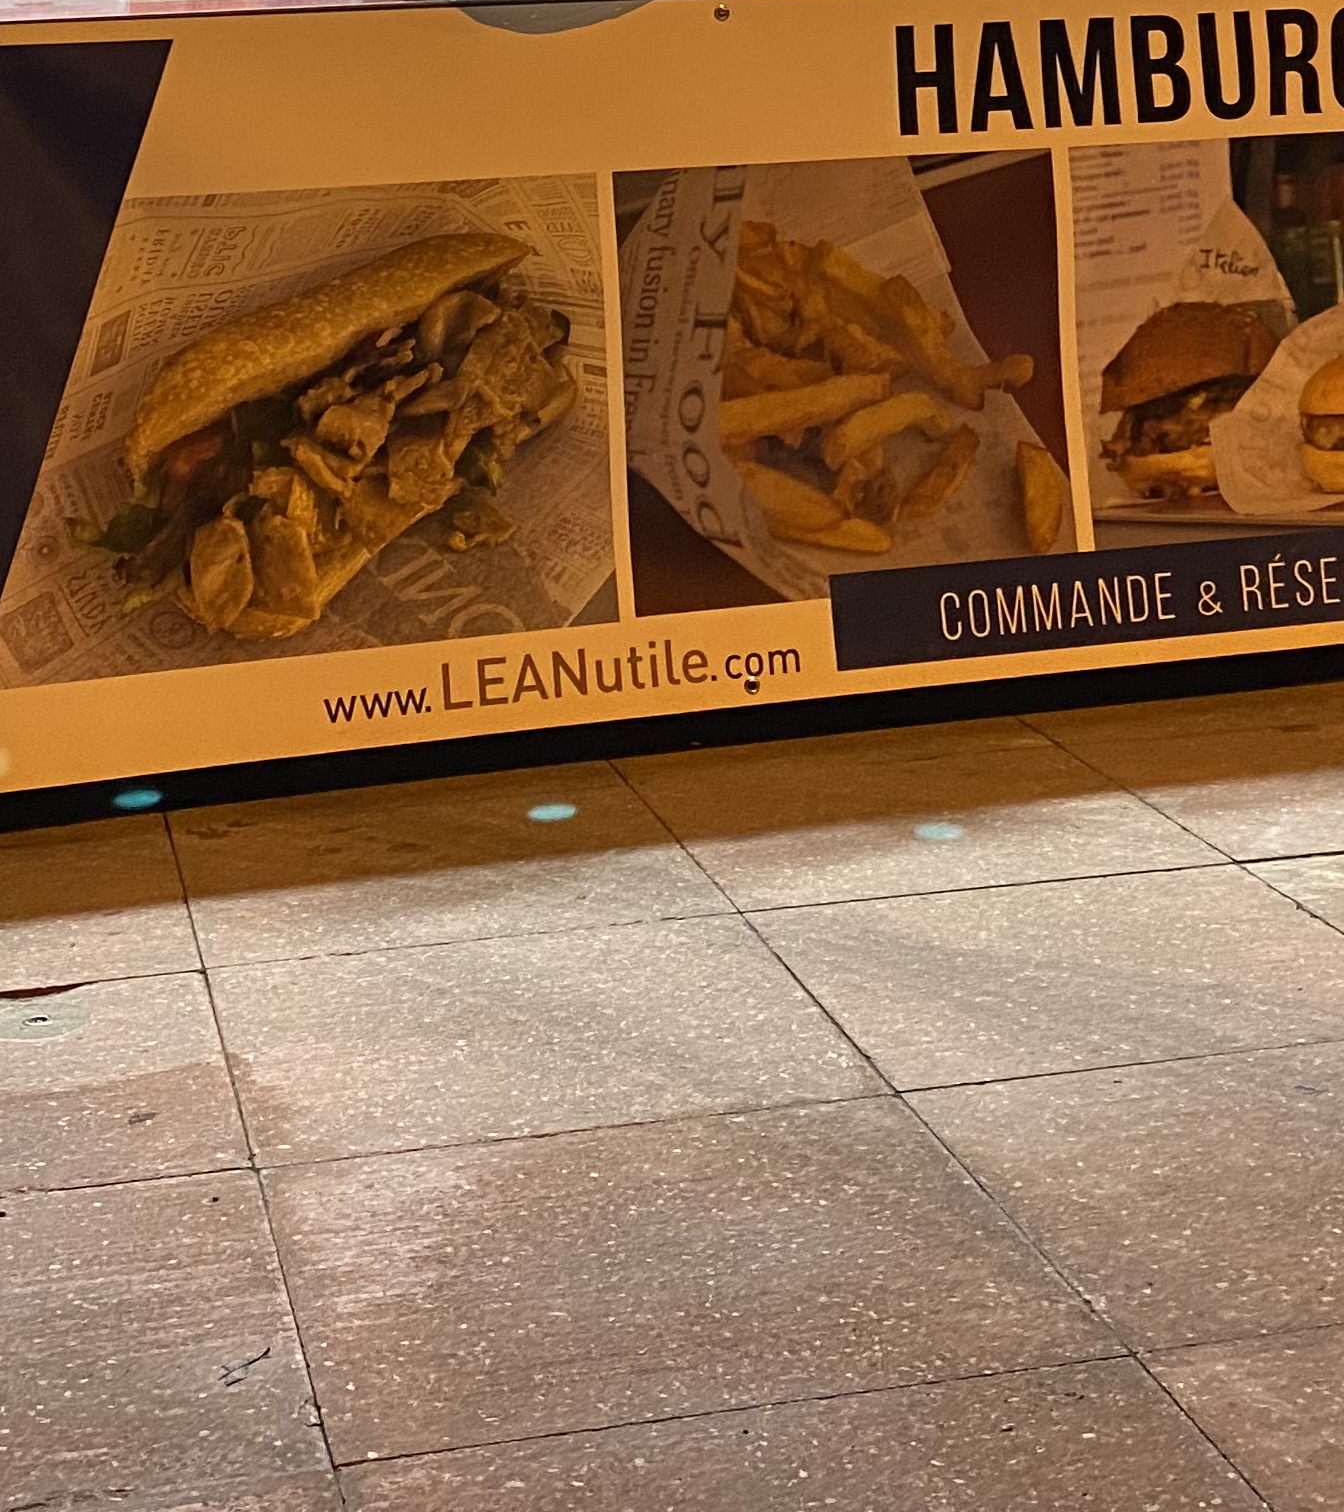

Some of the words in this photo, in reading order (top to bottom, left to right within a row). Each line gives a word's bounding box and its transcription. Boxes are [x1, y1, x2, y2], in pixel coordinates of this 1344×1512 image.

[634, 246, 679, 330] fusion
[627, 340, 658, 364] in
[940, 570, 1178, 641] COMMANDE
[1198, 580, 1225, 616] &
[322, 639, 802, 724] www.LEANutile.com
